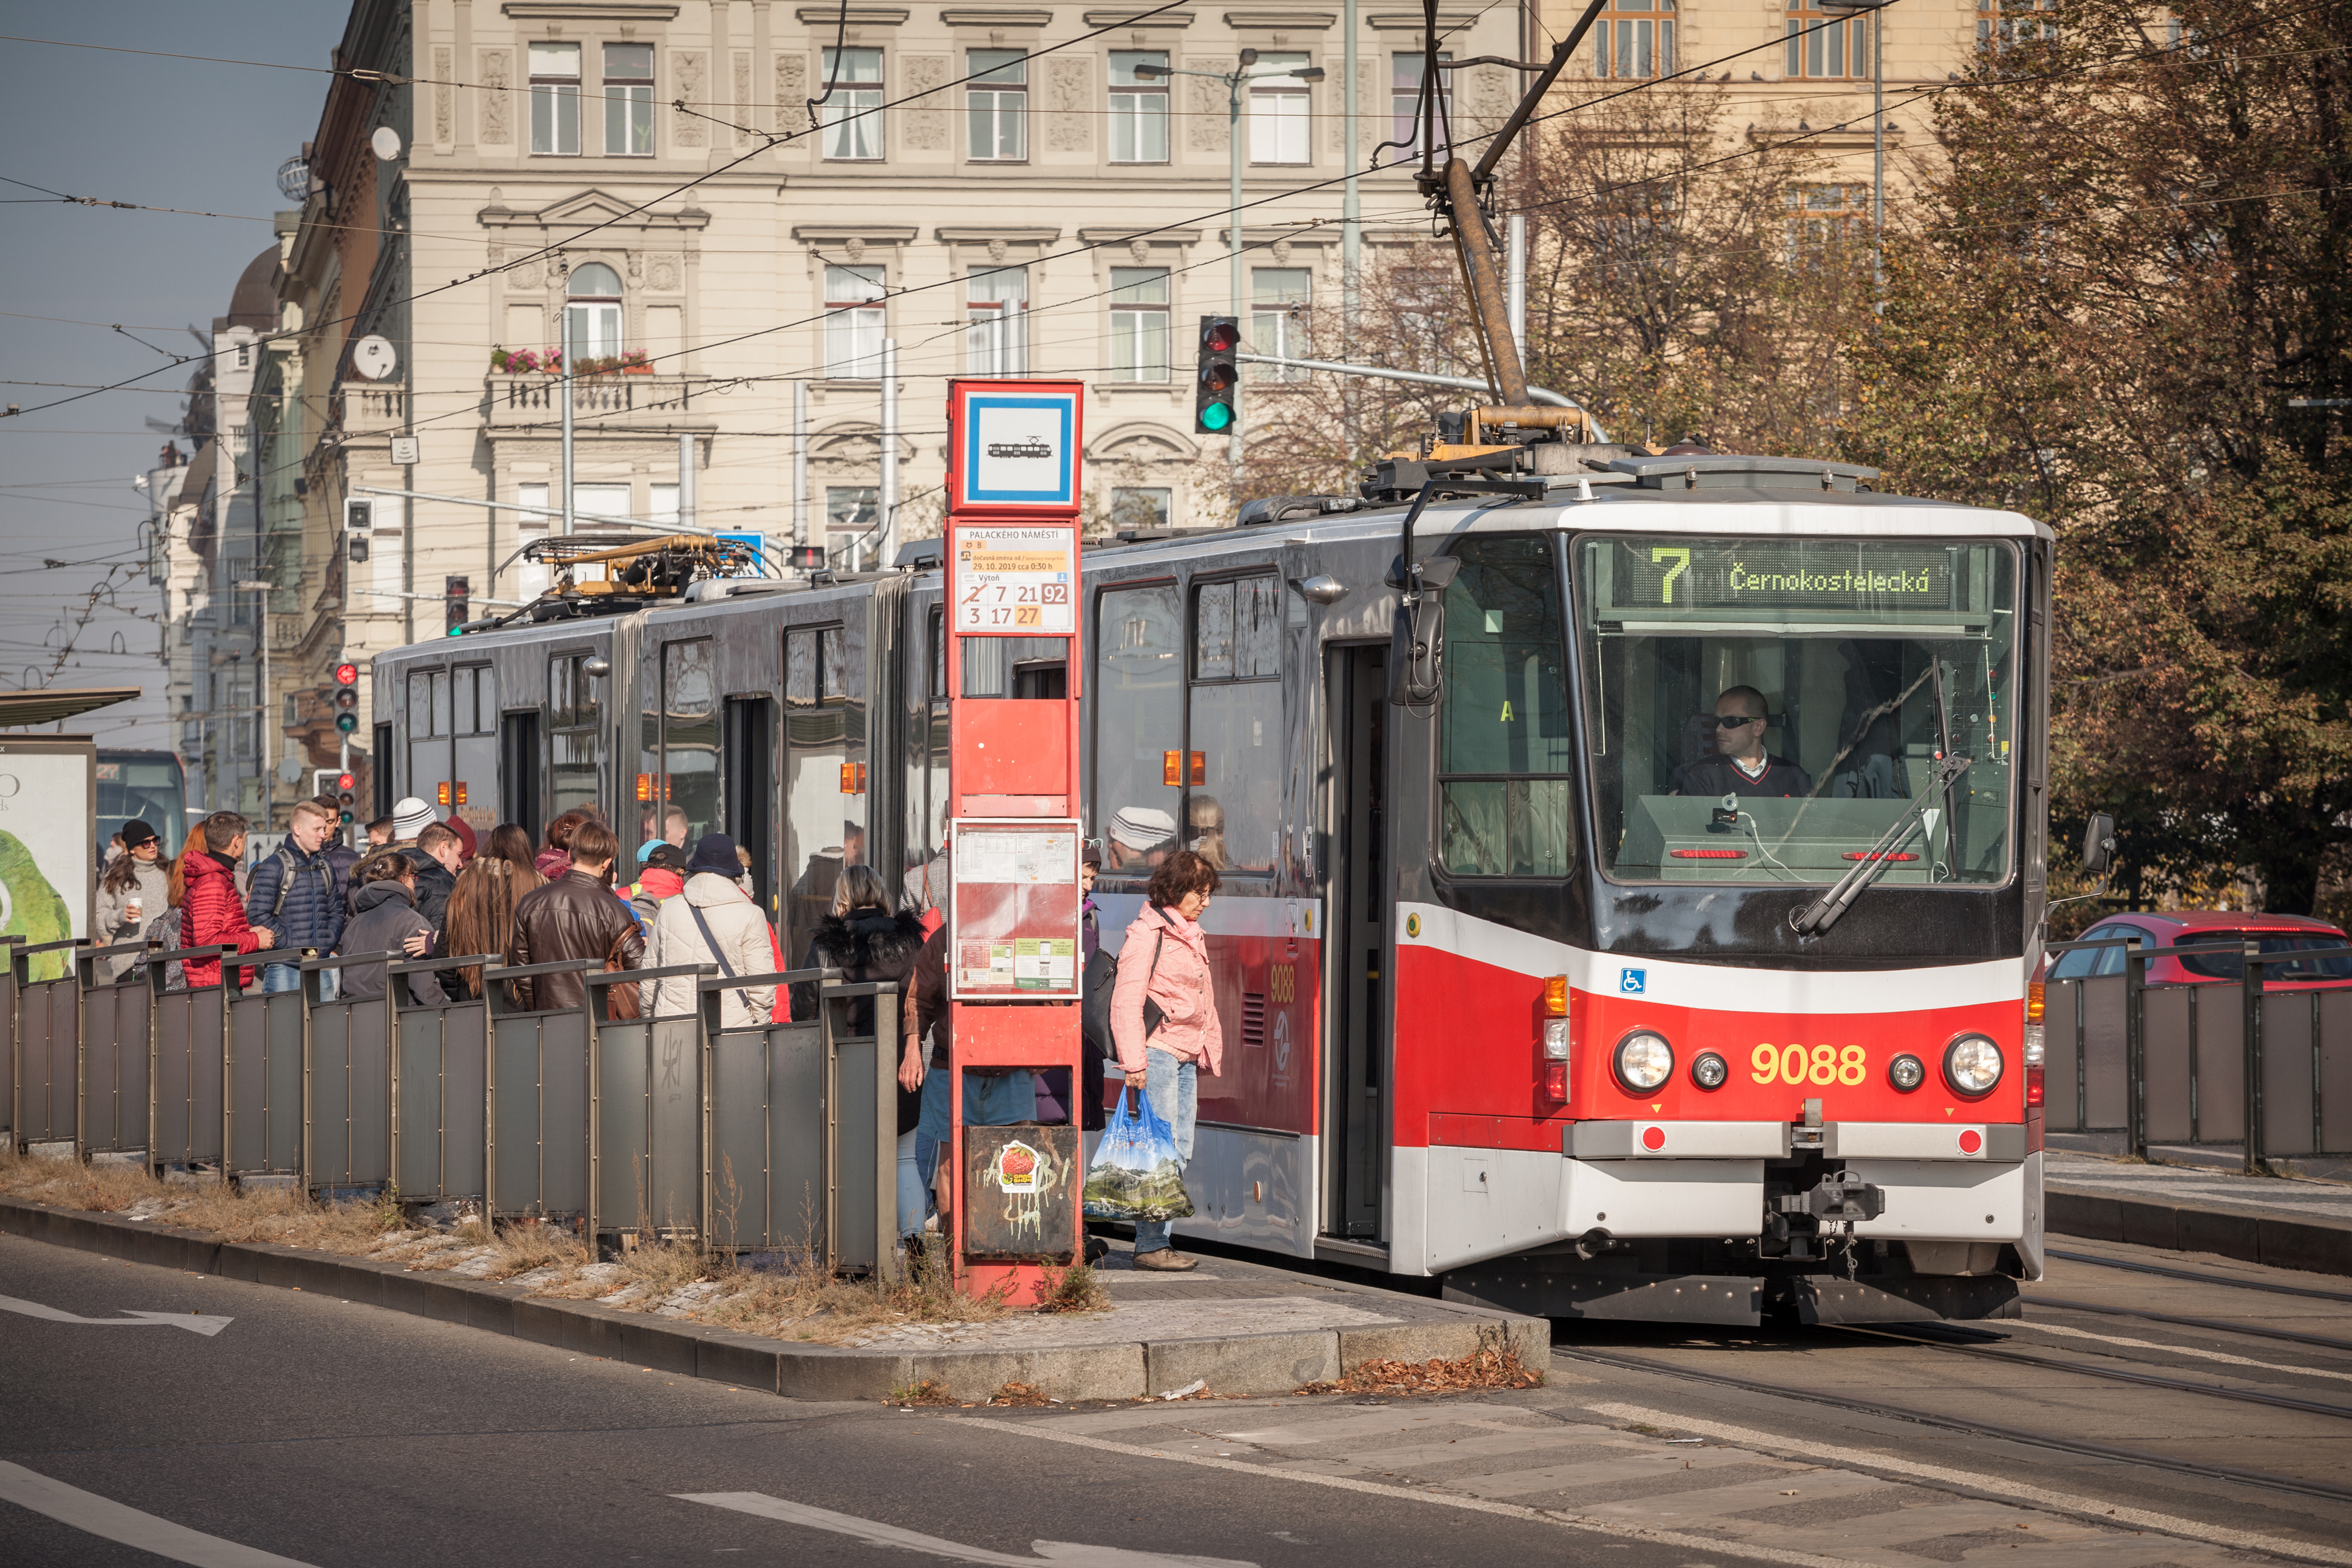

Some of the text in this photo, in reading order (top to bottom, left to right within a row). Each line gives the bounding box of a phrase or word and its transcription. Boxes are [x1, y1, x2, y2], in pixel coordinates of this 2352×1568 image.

[970, 530, 1058, 539] PALACKÉHO NÁMĚSTÍ
[979, 575, 1000, 583] Výtoň
[1651, 548, 1690, 604] 7
[1730, 562, 1929, 592] Černokostelecká
[970, 586, 1065, 603] 2 7 21 92
[970, 608, 1038, 624] 3 17 27
[1500, 701, 1514, 721] A
[96, 764, 118, 779] 27
[1271, 964, 1294, 1003] 9088
[1751, 1043, 1866, 1086] 9088
